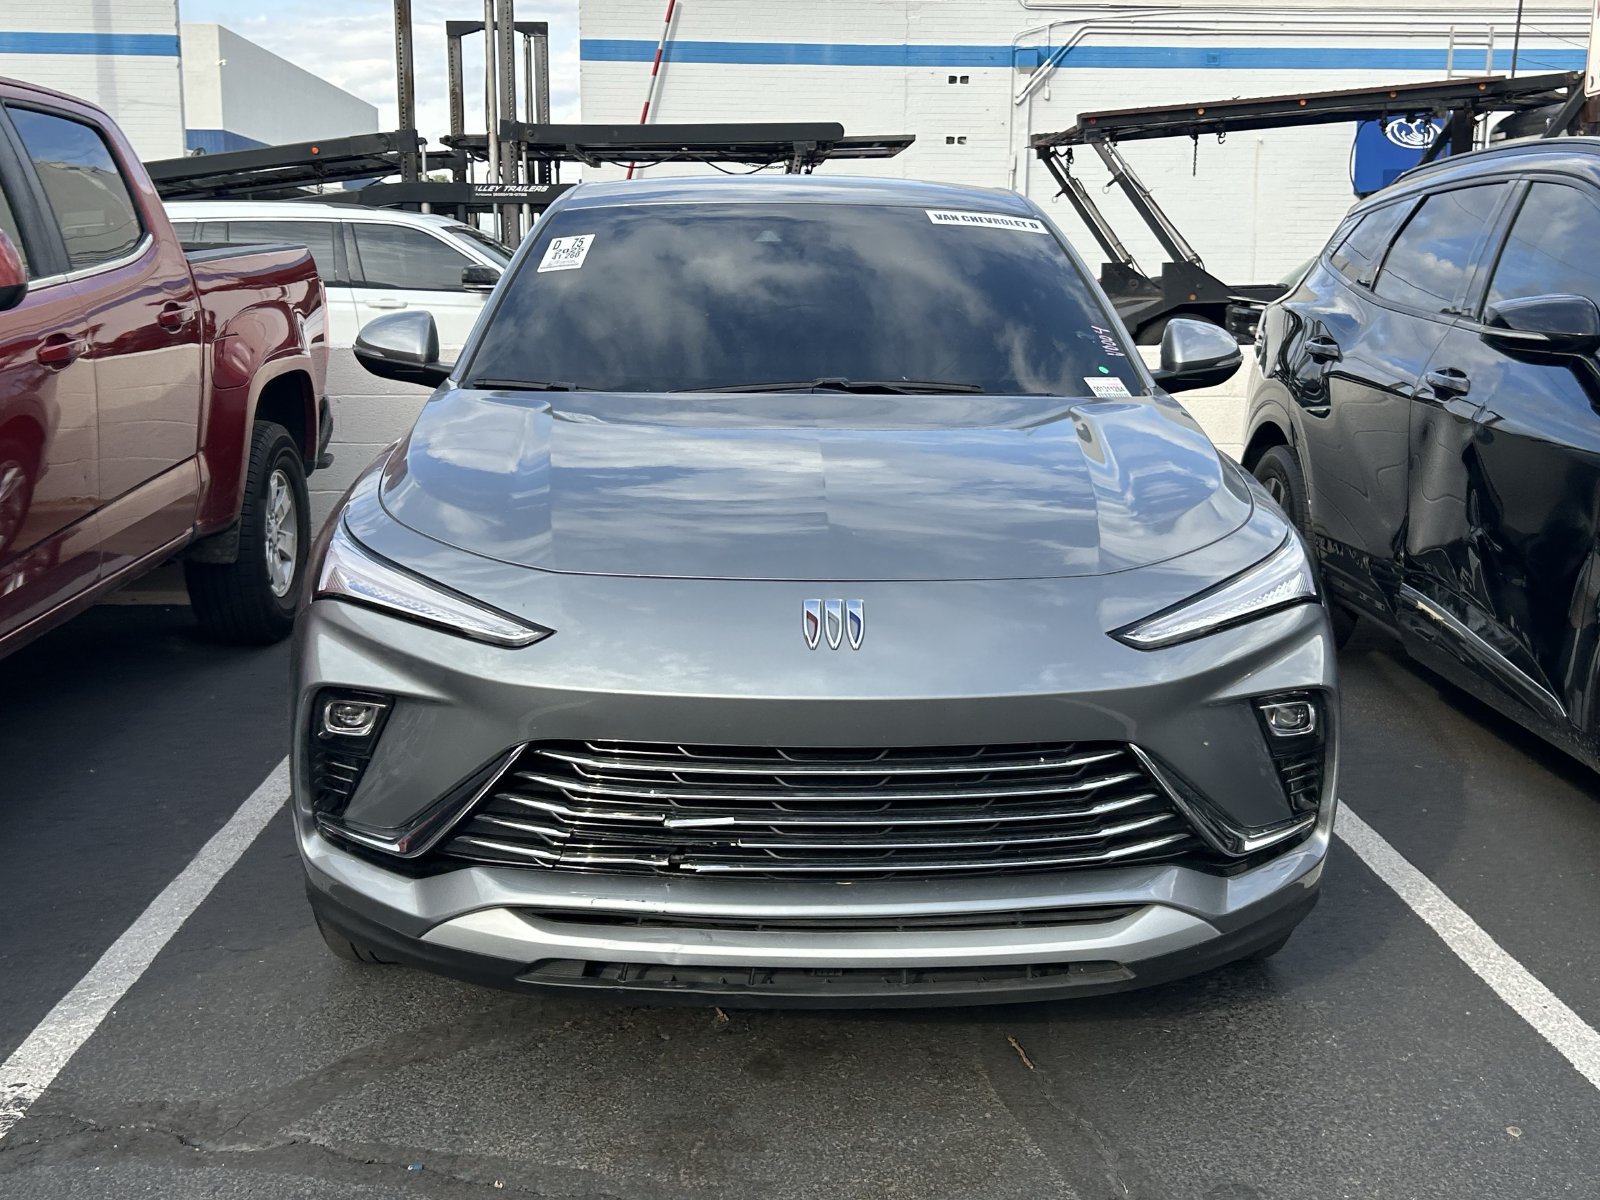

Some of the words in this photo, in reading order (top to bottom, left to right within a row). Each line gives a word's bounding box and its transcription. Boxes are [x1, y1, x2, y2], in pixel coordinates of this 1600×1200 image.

[933, 213, 960, 222] VAN
[960, 215, 1028, 228] CHEVROLET
[552, 239, 562, 251] D
[571, 237, 586, 249] 75
